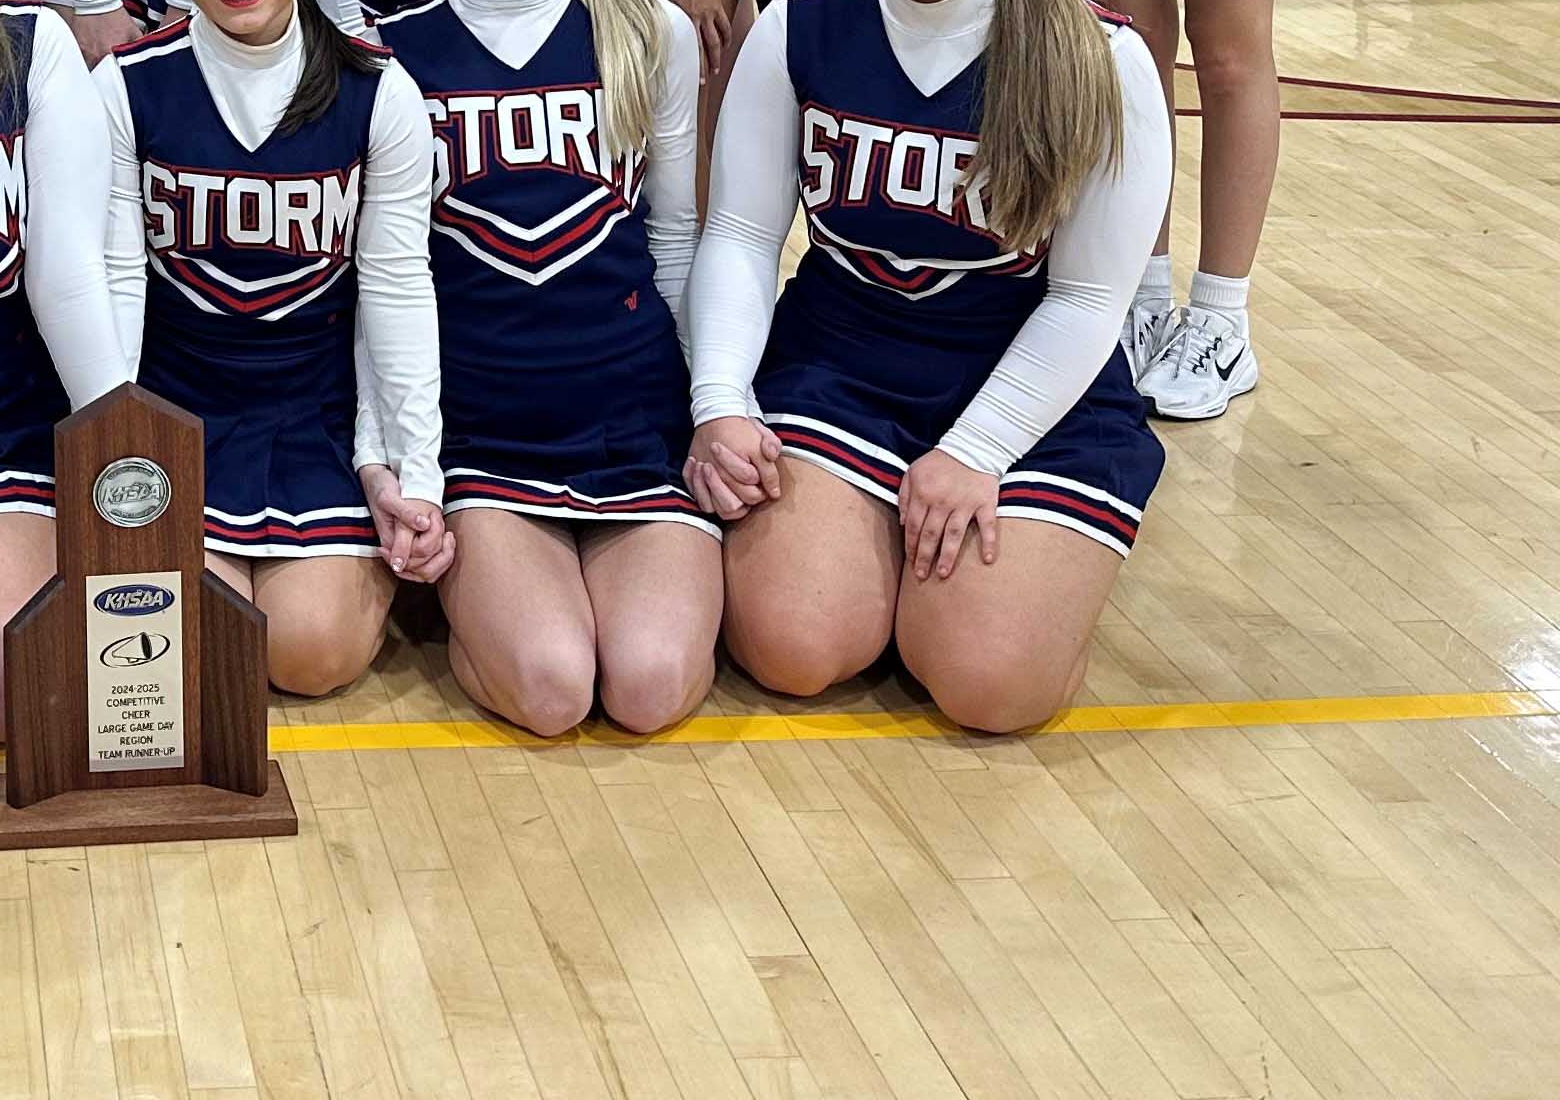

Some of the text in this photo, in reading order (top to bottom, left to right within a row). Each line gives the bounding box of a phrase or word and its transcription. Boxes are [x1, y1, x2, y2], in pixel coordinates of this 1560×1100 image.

[803, 106, 1015, 248] STOR
[144, 160, 361, 257] STORM
[103, 589, 165, 611] KHSAA
[111, 683, 160, 695] 2024-2025
[106, 696, 166, 707] COMPETITIVE
[121, 710, 151, 720] CHEER
[97, 721, 175, 734] LARGE GAME DAY
[119, 736, 153, 746] REGION
[98, 746, 176, 760] TEAM RUNNER-UP
